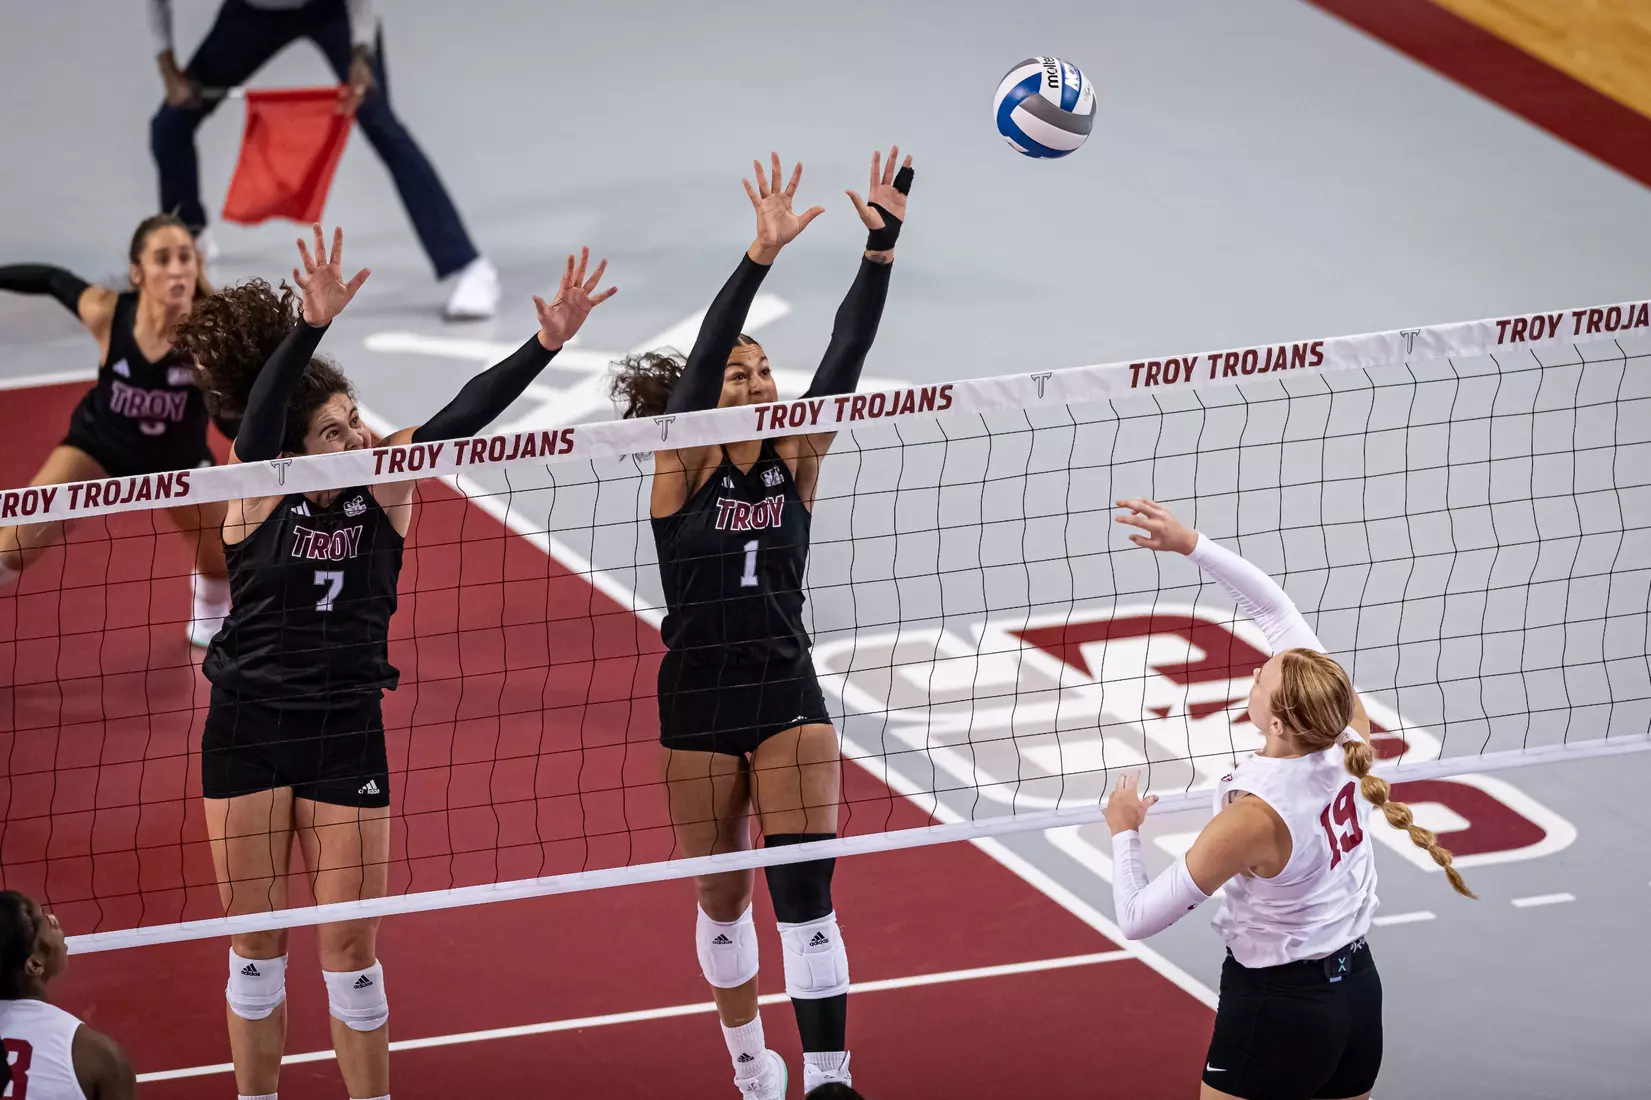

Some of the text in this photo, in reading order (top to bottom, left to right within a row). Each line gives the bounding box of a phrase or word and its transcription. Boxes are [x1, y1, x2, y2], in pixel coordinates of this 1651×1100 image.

[1042, 56, 1060, 88] molte
[1496, 303, 1650, 345] TROY TROJA
[1129, 341, 1324, 388] TROY TROJANS
[110, 380, 188, 422] TROY
[754, 384, 953, 432] TROY TROJANS
[373, 428, 575, 475] TROY TROJANS
[0, 471, 190, 518] ROY TROJANS
[715, 494, 784, 531] TROY
[291, 525, 363, 561] TROY
[741, 540, 758, 587] 1
[314, 570, 344, 611] 7
[1320, 781, 1363, 871] 19
